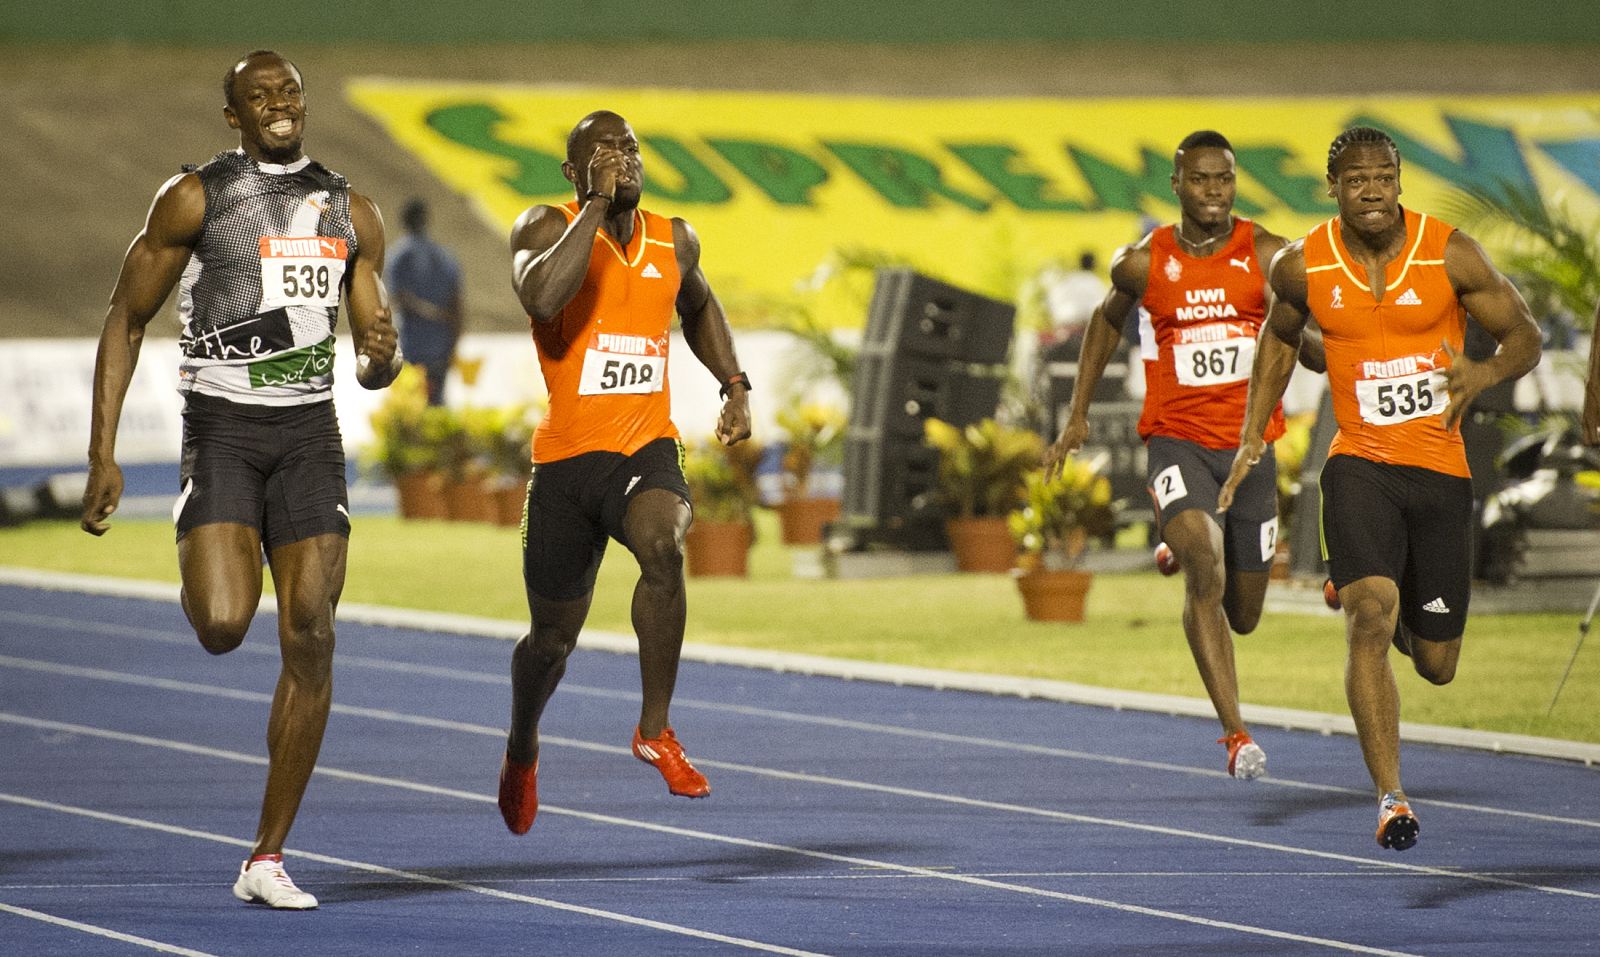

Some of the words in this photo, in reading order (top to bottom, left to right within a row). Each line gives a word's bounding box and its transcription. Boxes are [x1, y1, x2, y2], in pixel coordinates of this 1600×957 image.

[423, 102, 1341, 213] SUPREME
[269, 239, 322, 257] PUMA
[282, 265, 330, 299] 539
[1185, 288, 1226, 304] UWI
[1176, 304, 1238, 321] MONA
[597, 333, 647, 355] PUMA
[1181, 323, 1228, 344] PUMA
[1192, 345, 1240, 378] 867
[1363, 356, 1418, 379] PUMA
[1377, 378, 1433, 417] 535
[1161, 475, 1176, 495] 2
[1267, 526, 1275, 549] 2
